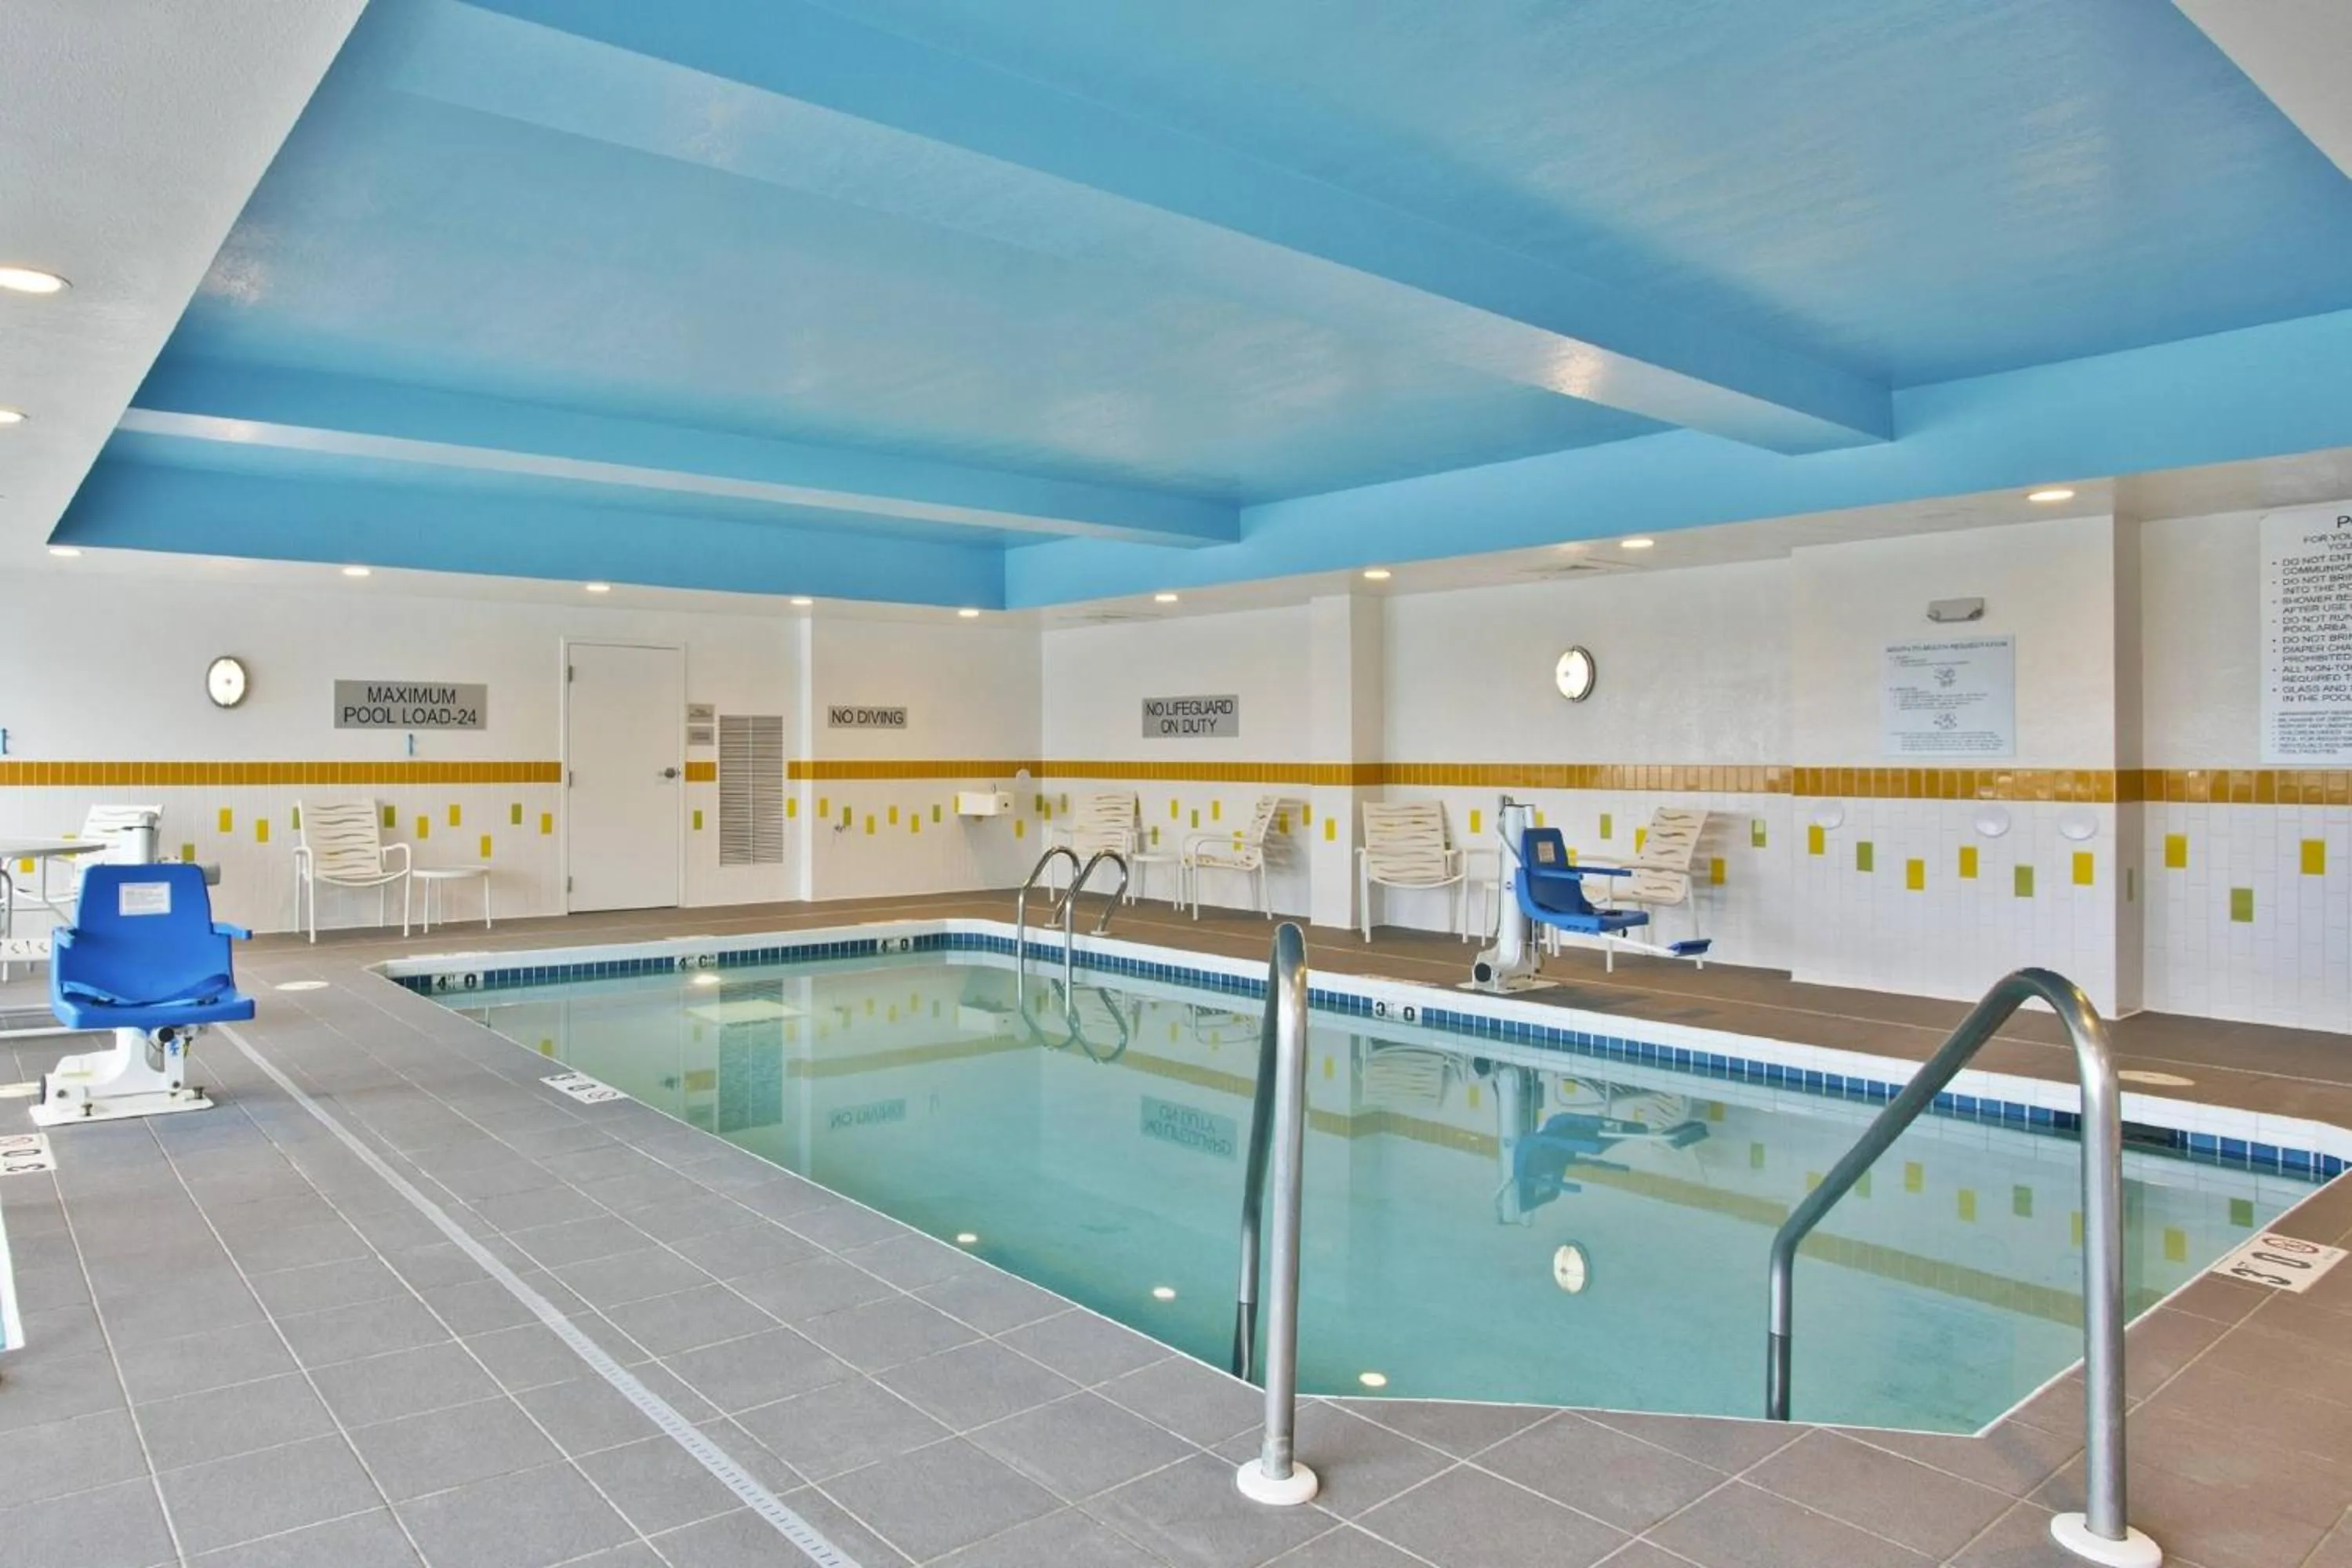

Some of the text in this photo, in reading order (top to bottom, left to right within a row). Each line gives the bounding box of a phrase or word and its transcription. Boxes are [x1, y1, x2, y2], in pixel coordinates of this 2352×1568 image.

[2337, 515, 2352, 528] P
[2282, 557, 2299, 566] DO
[2302, 555, 2325, 564] NOT
[2282, 577, 2299, 586] DO
[2302, 575, 2325, 584] NOT
[2282, 586, 2310, 594] INTO
[2282, 594, 2332, 604] SHOWER
[2282, 603, 2347, 614] AFTER USE
[2282, 616, 2299, 625] DO
[2303, 615, 2325, 623] NOT
[2282, 625, 2315, 633] POOL
[2282, 636, 2299, 644] DO
[2302, 634, 2325, 643] NOT
[2282, 684, 2347, 693] GLASS AND
[367, 686, 456, 705] MAXIMUM
[2298, 693, 2319, 702] THE
[1145, 699, 1233, 717] NO LIFEGUARD
[343, 706, 477, 725] POOL LOAD-24
[832, 709, 904, 724] NO DIVING
[1161, 717, 1218, 734] ON DUTY
